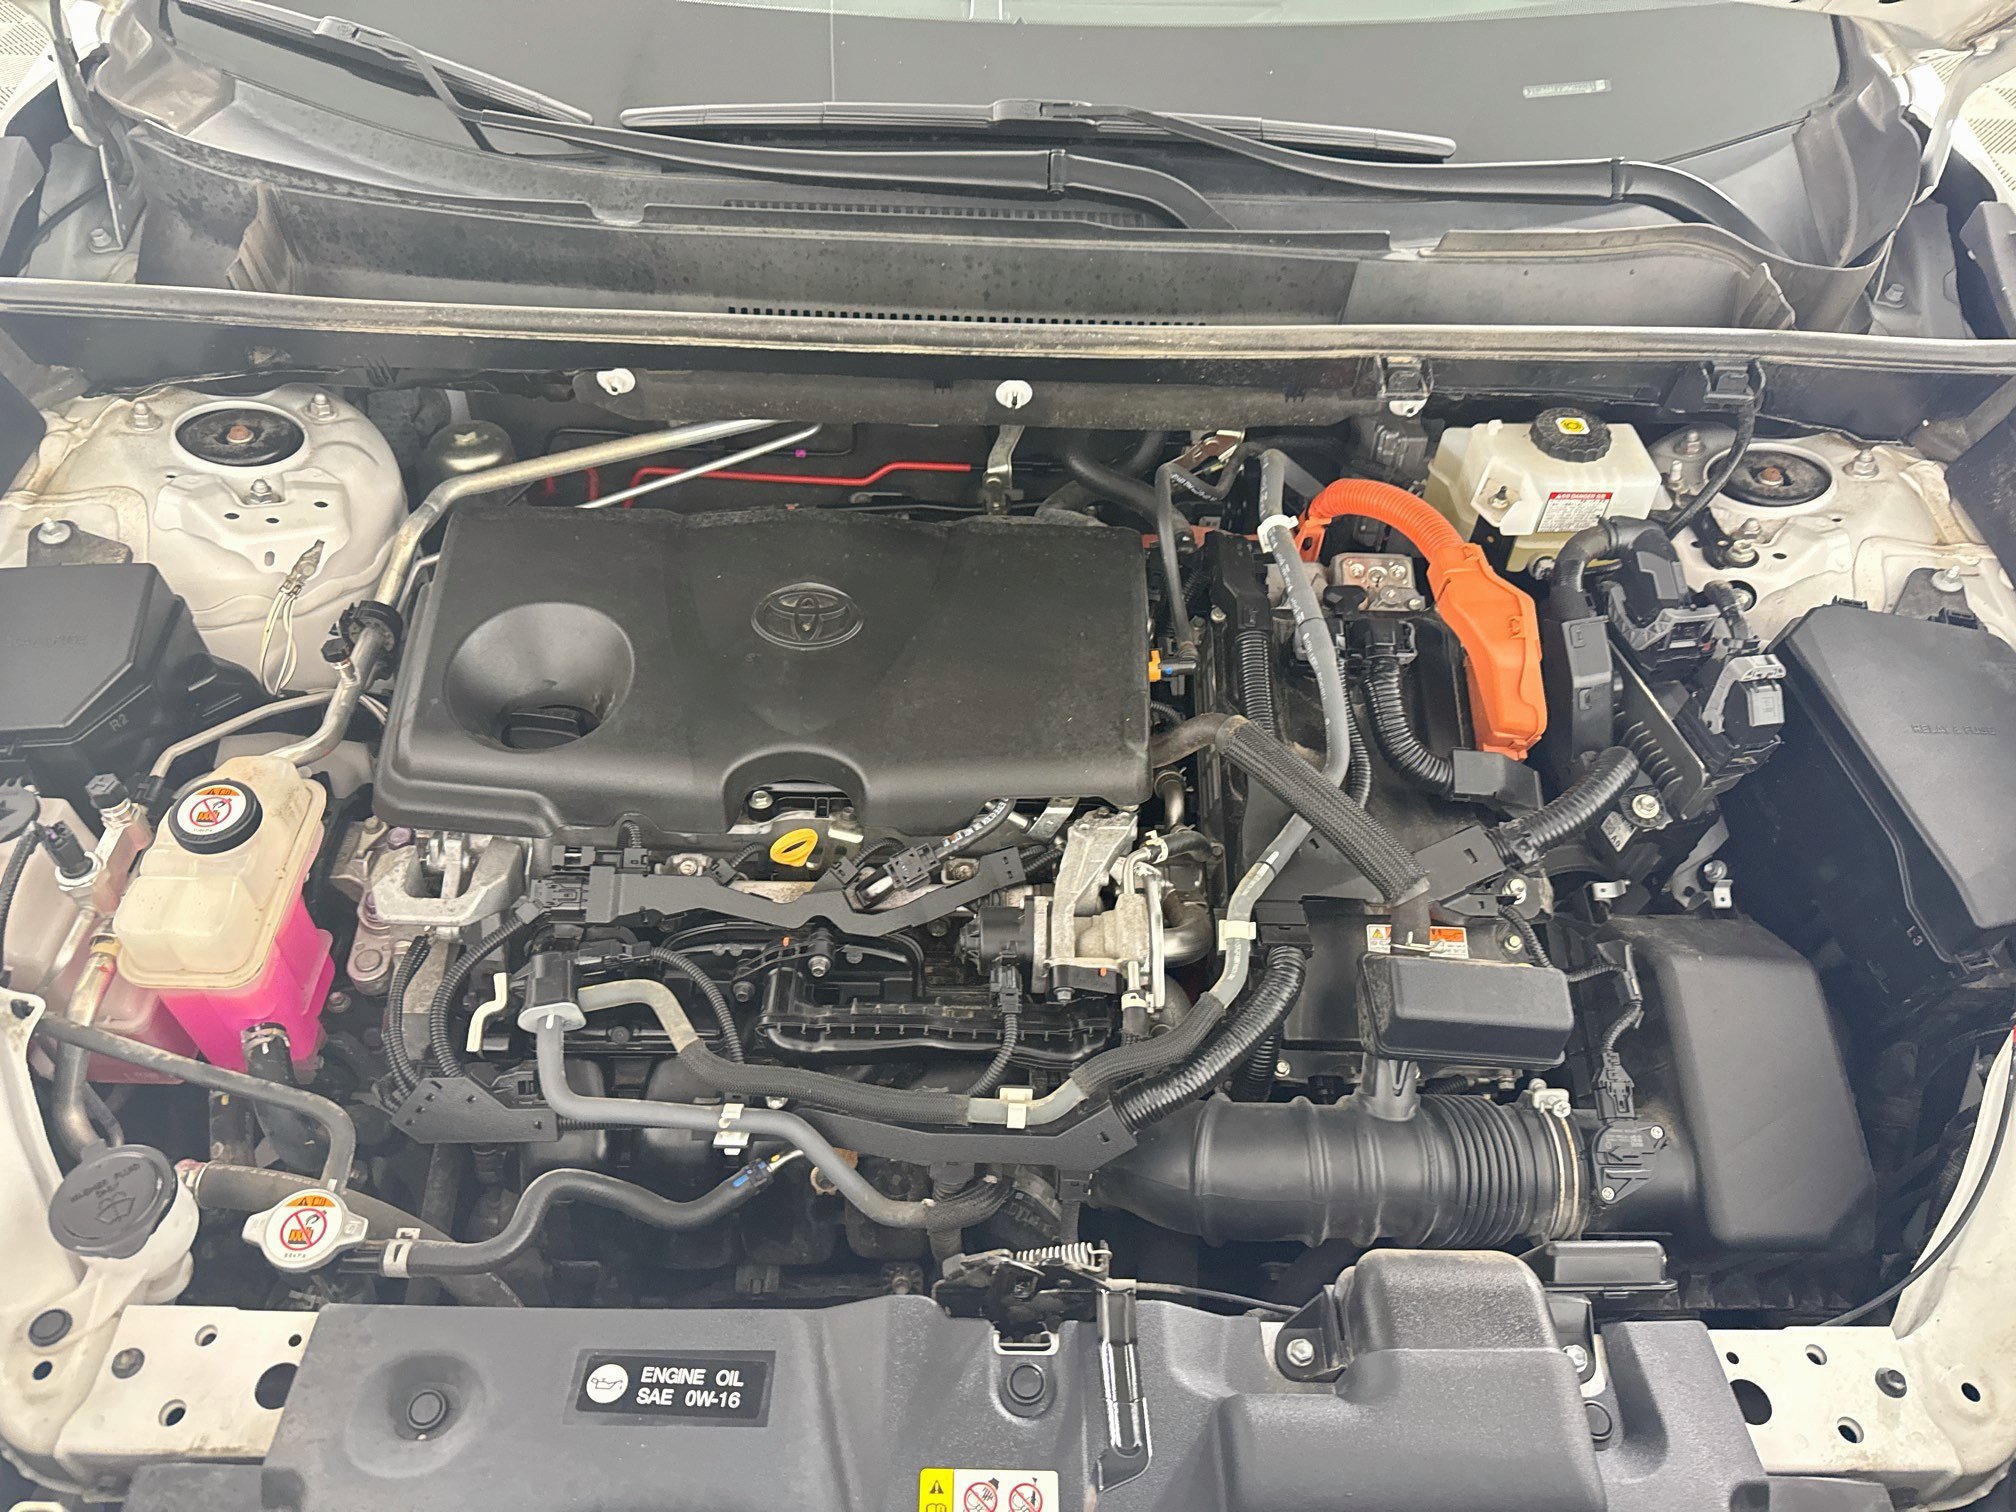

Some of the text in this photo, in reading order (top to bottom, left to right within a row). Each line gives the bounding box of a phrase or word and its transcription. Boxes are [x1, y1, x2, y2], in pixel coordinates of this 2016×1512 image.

[109, 713, 129, 732] R2
[640, 1366, 744, 1387] ENGINE OIL
[636, 1387, 741, 1409] SAE 0W-16
